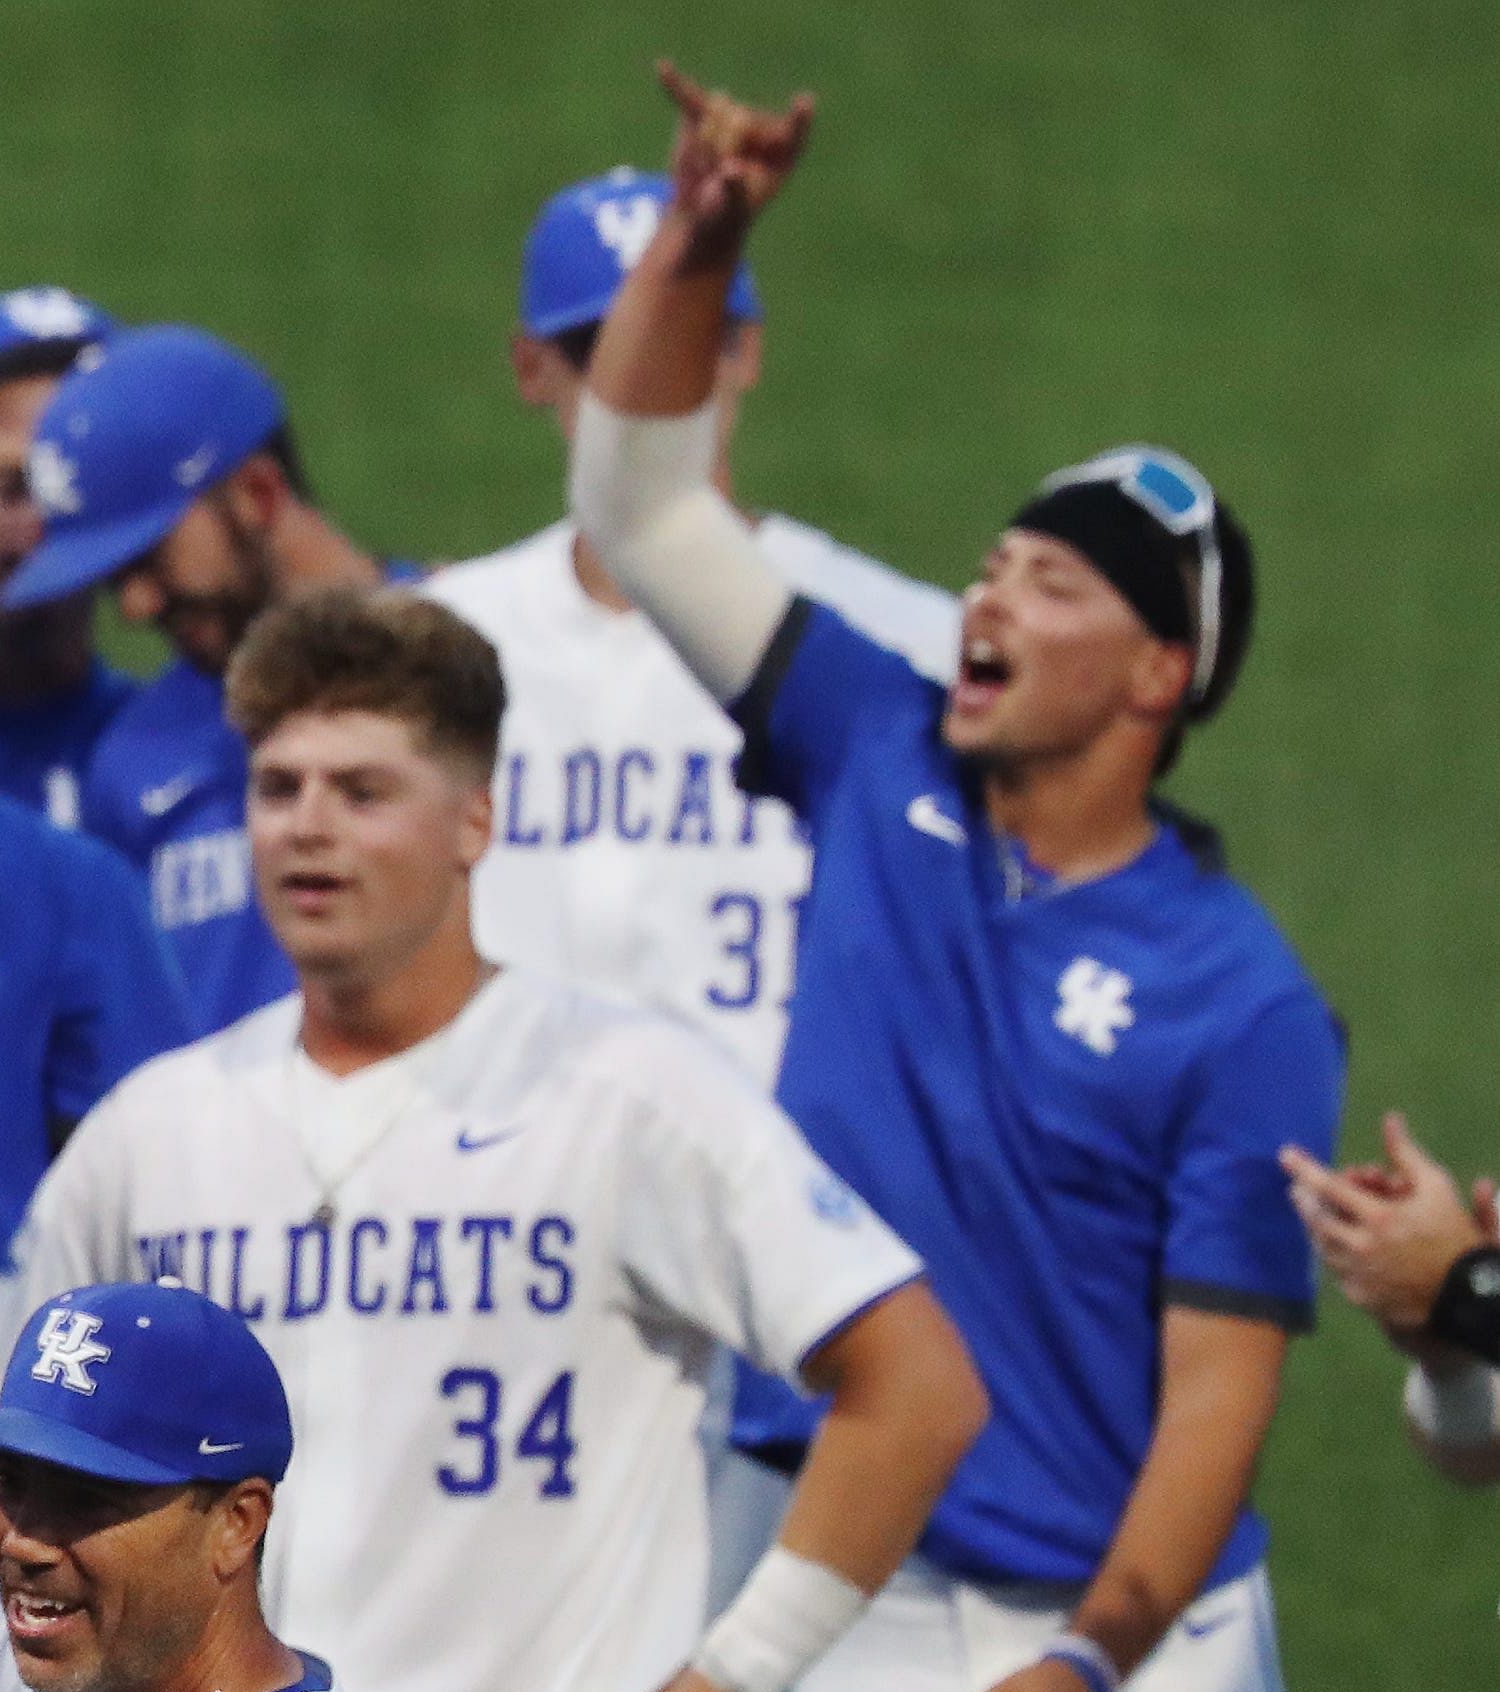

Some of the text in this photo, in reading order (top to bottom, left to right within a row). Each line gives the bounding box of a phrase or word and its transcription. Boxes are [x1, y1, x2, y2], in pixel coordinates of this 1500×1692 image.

[1053, 956, 1135, 1056] UK
[135, 1215, 576, 1323] WILDCATS
[30, 1308, 112, 1396] UK
[435, 1367, 577, 1500] 34
